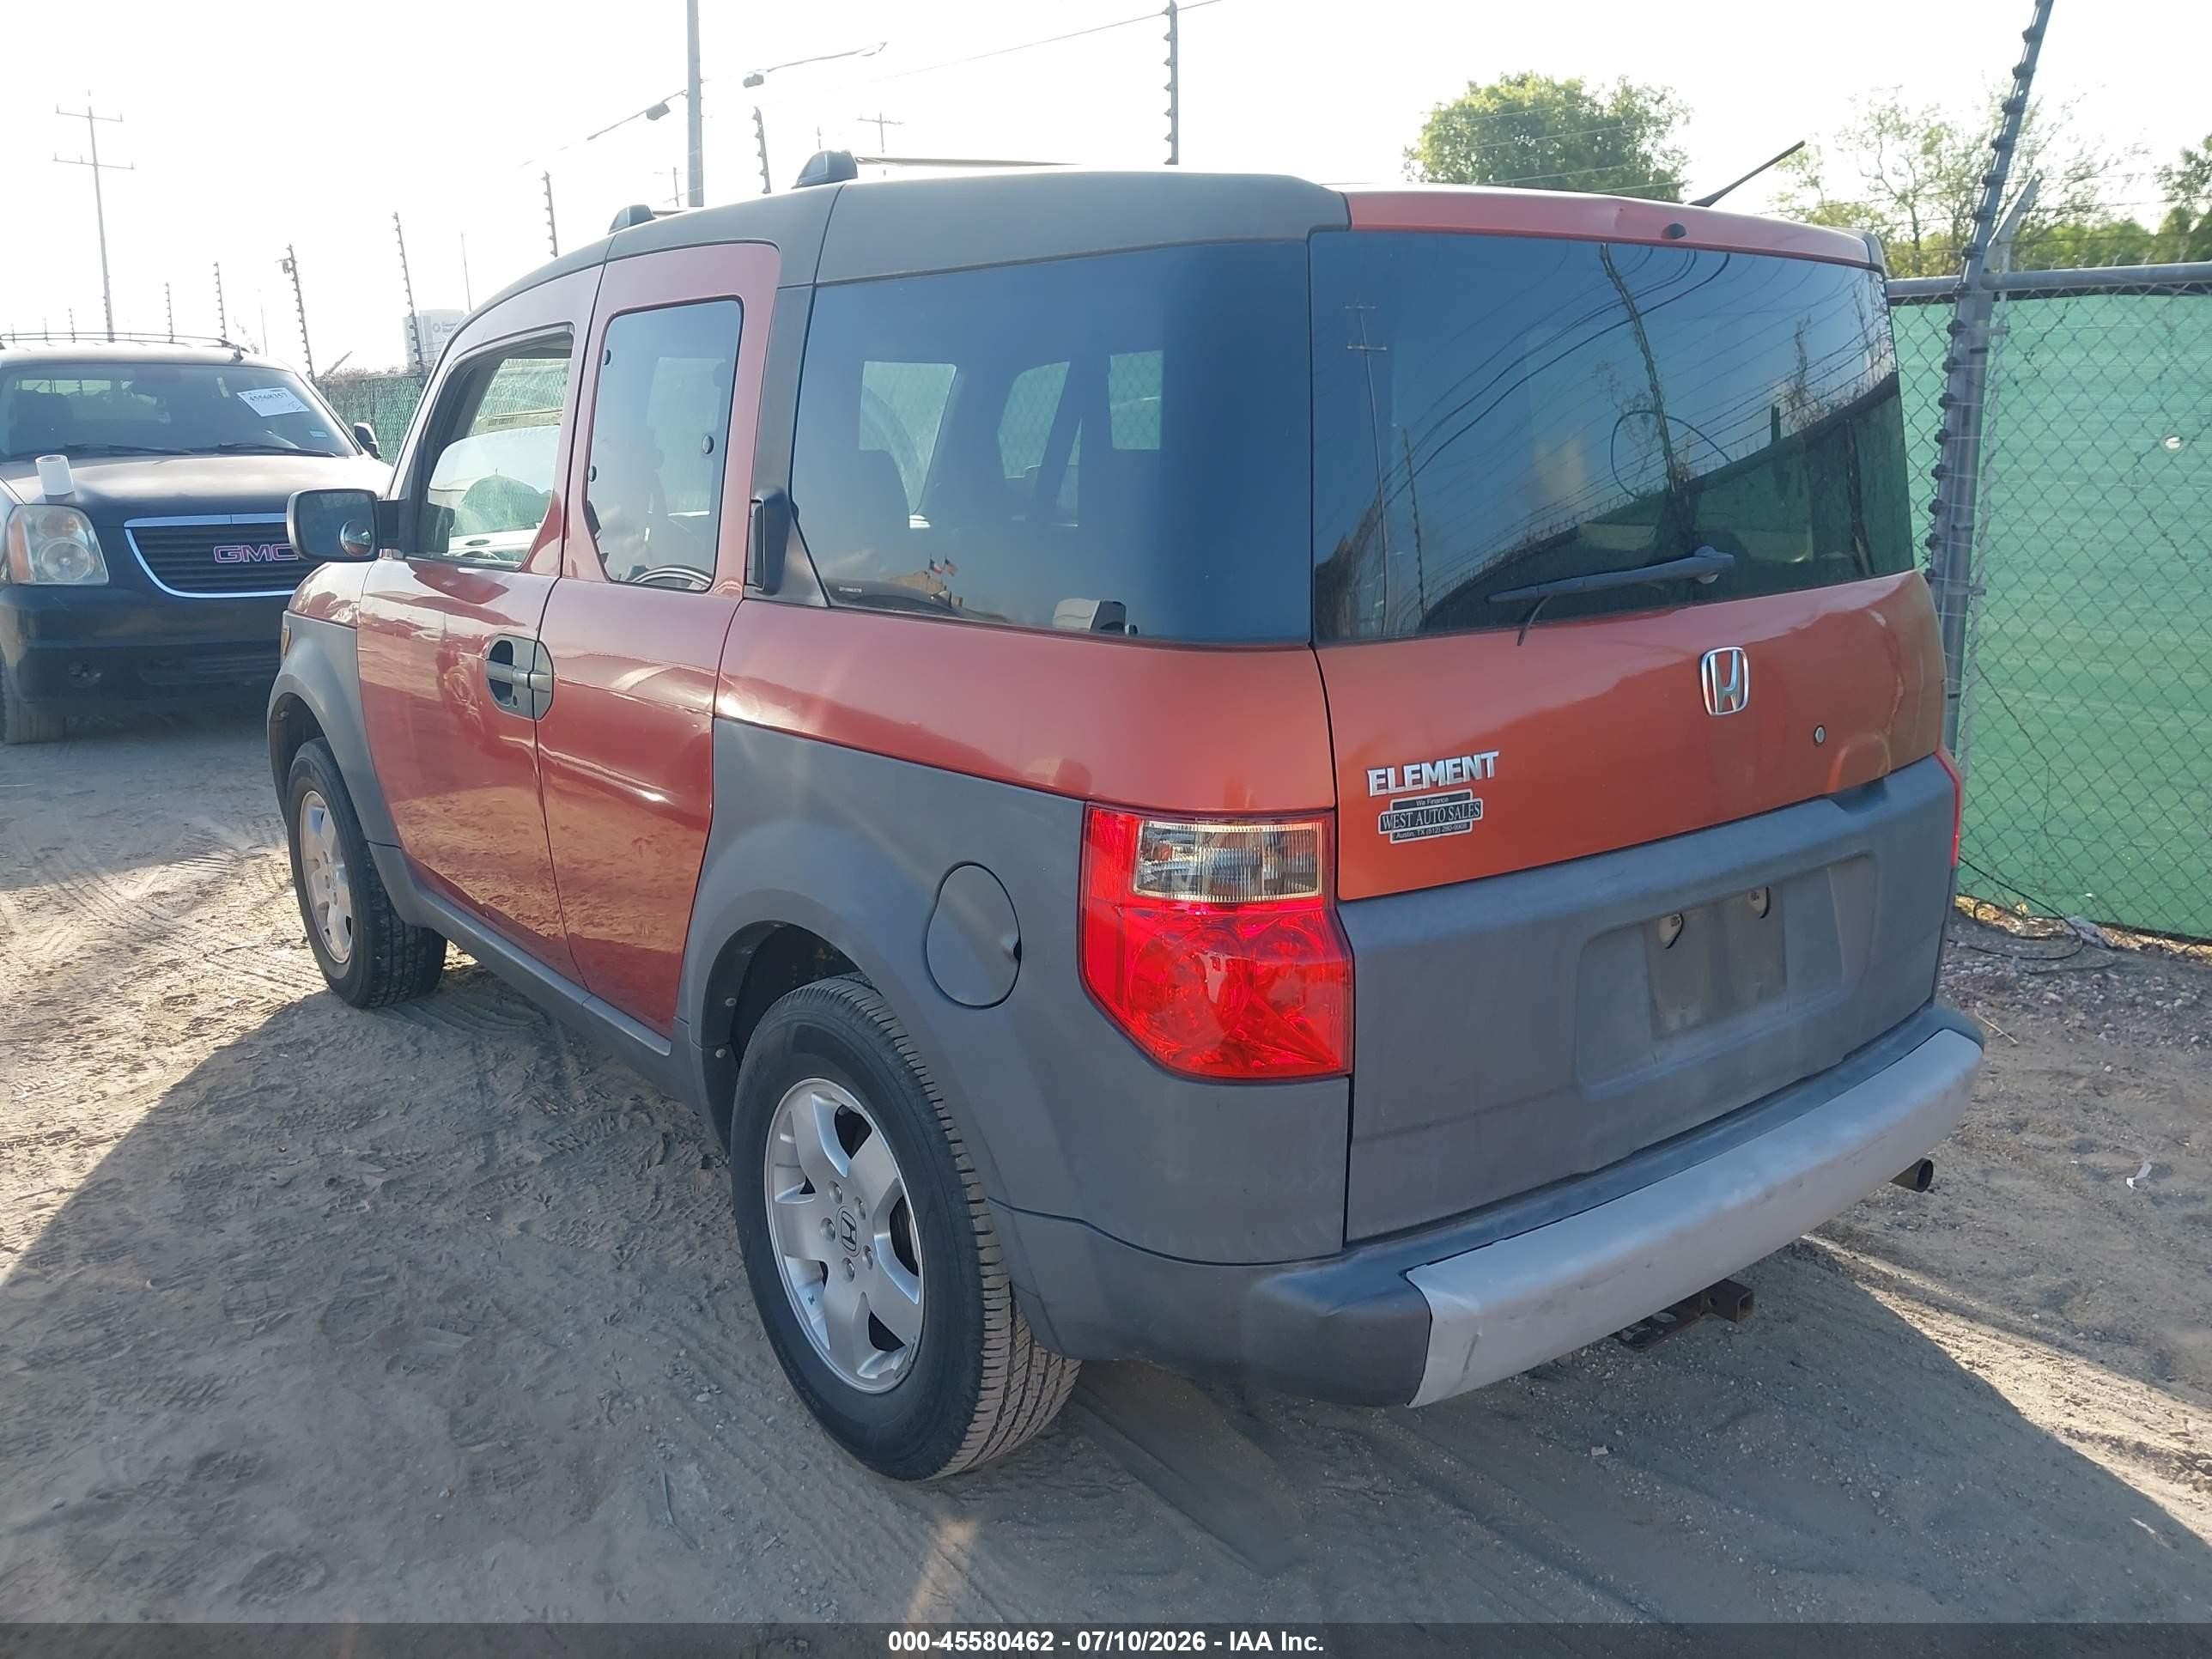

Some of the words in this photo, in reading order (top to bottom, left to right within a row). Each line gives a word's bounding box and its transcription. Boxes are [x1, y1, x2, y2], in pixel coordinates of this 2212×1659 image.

[213, 543, 299, 563] GMC
[1366, 750, 1499, 797] ELEMENT
[1382, 811, 1413, 830] WEST
[1415, 807, 1446, 826] AUTO
[1448, 802, 1480, 821] SALES
